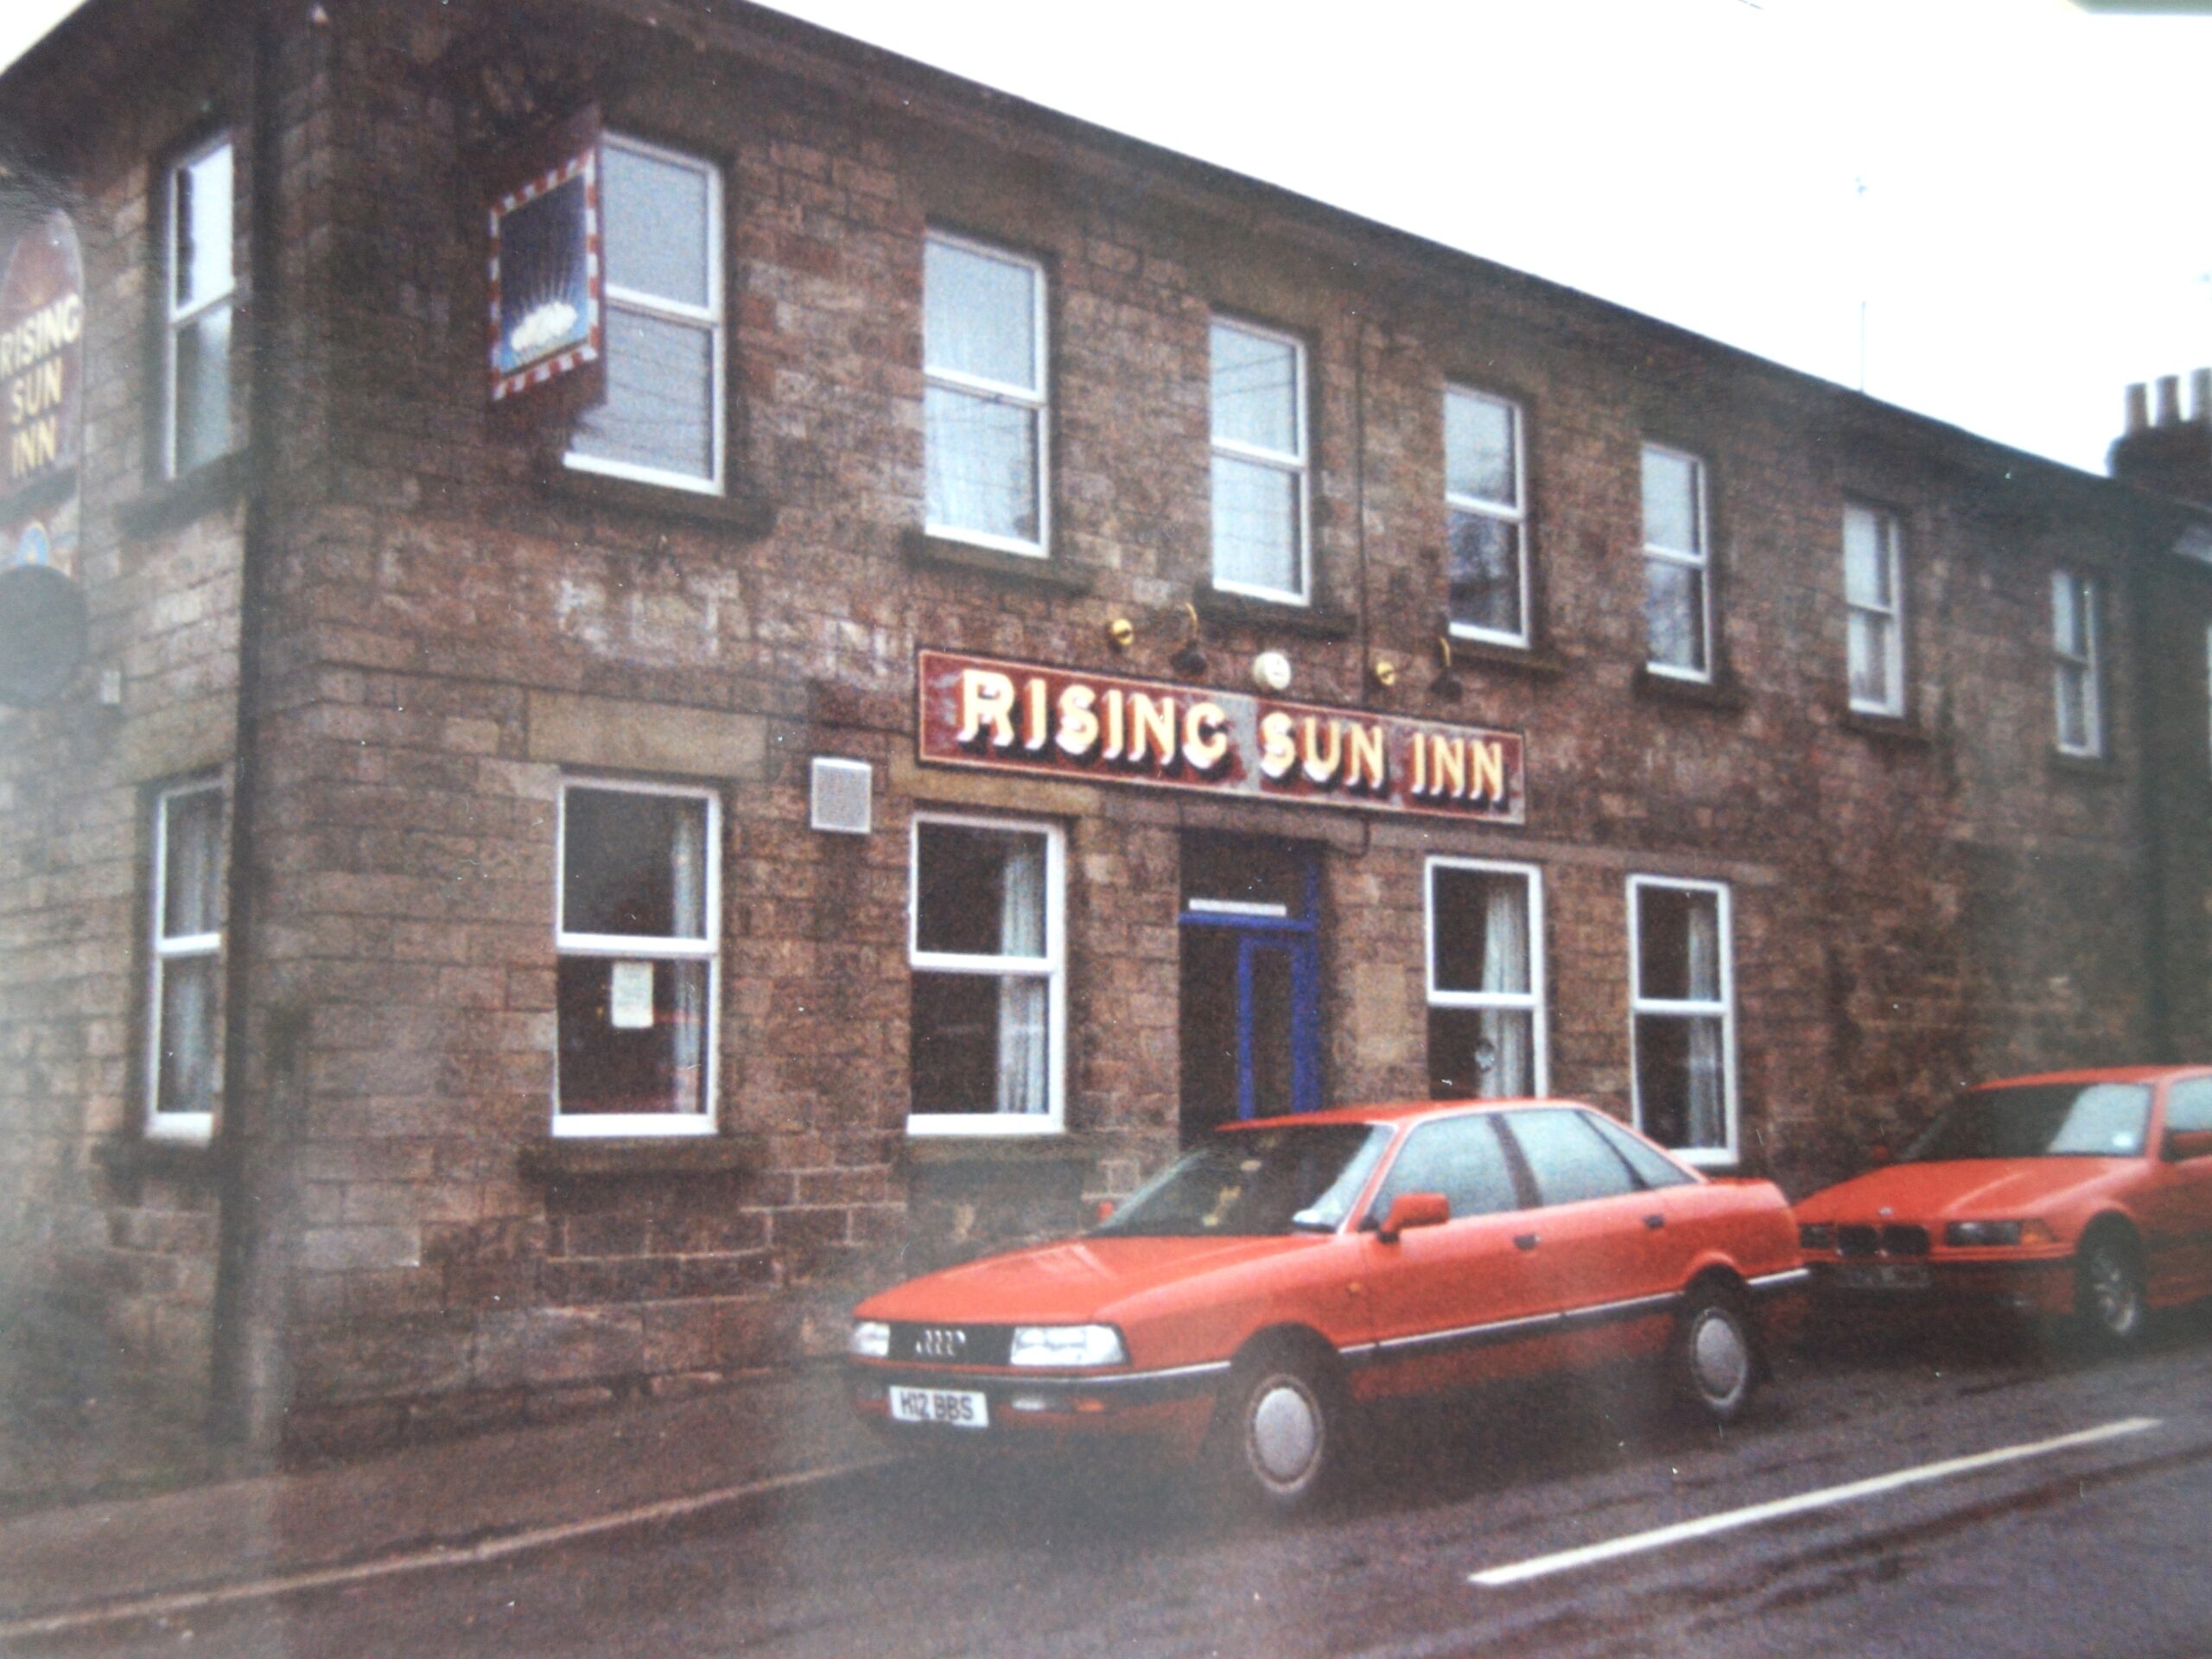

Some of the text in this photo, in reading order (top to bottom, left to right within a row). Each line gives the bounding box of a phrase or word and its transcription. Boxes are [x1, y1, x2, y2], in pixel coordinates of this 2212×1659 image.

[0, 293, 83, 379] RISING
[11, 355, 62, 425] SUN
[12, 414, 56, 476] INN
[956, 668, 1505, 802] RISING SUN INN
